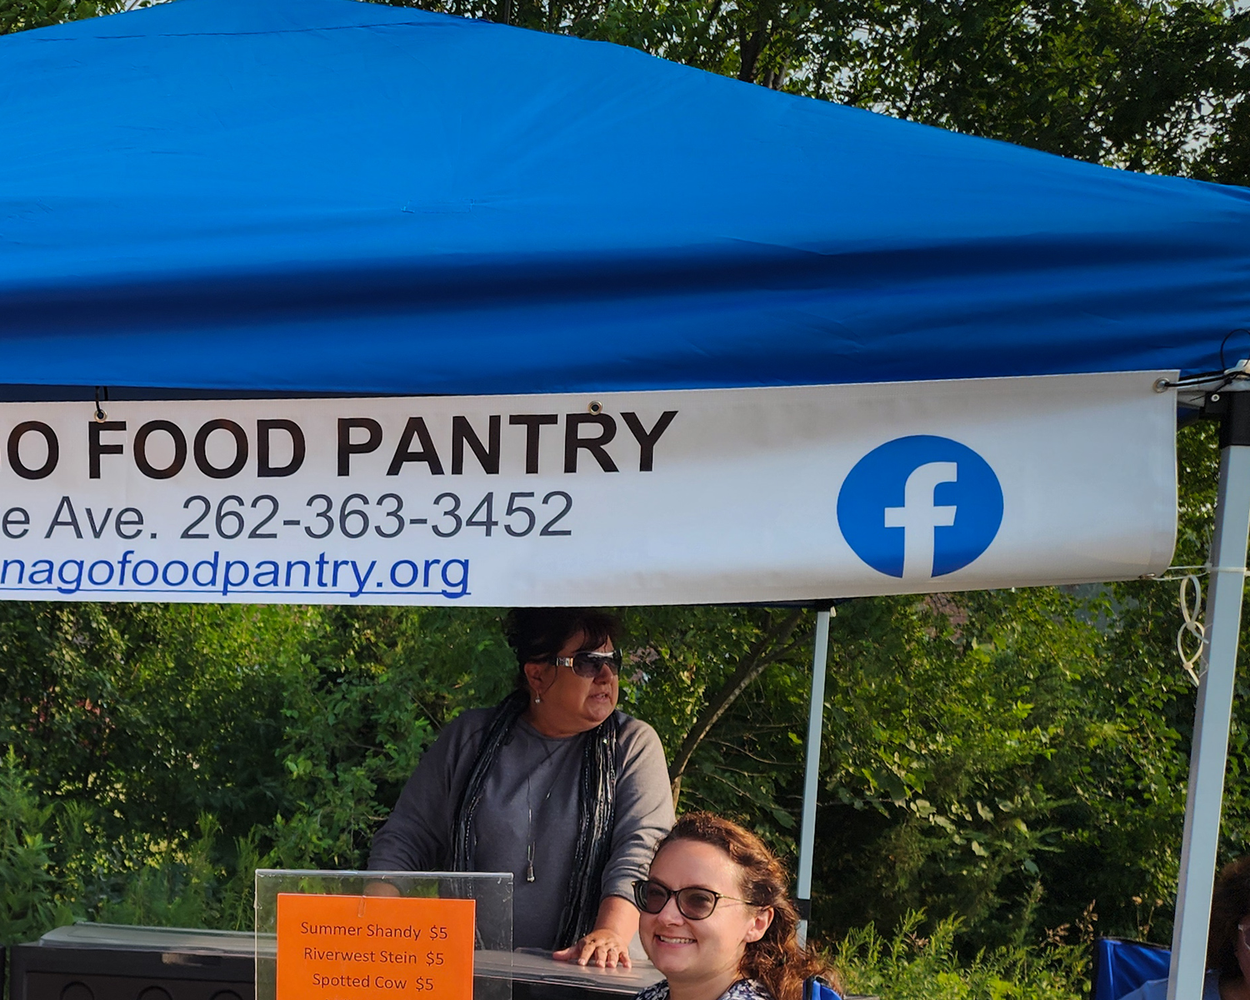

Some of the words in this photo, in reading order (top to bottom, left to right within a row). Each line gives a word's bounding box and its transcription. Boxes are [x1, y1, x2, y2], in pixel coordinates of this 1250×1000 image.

[88, 419, 306, 480] FOOD
[337, 410, 679, 478] PANTRY
[44, 496, 157, 541] Ave.
[180, 490, 573, 541] 262-363-3452
[301, 922, 362, 937] Summer
[367, 924, 421, 941] Shandy
[430, 926, 447, 940] $5
[304, 948, 376, 963] Riverwest
[380, 952, 417, 965] Stein
[426, 952, 444, 966] $5
[313, 973, 370, 989] Spotted
[375, 976, 407, 989] Cow
[416, 977, 433, 992] $5
